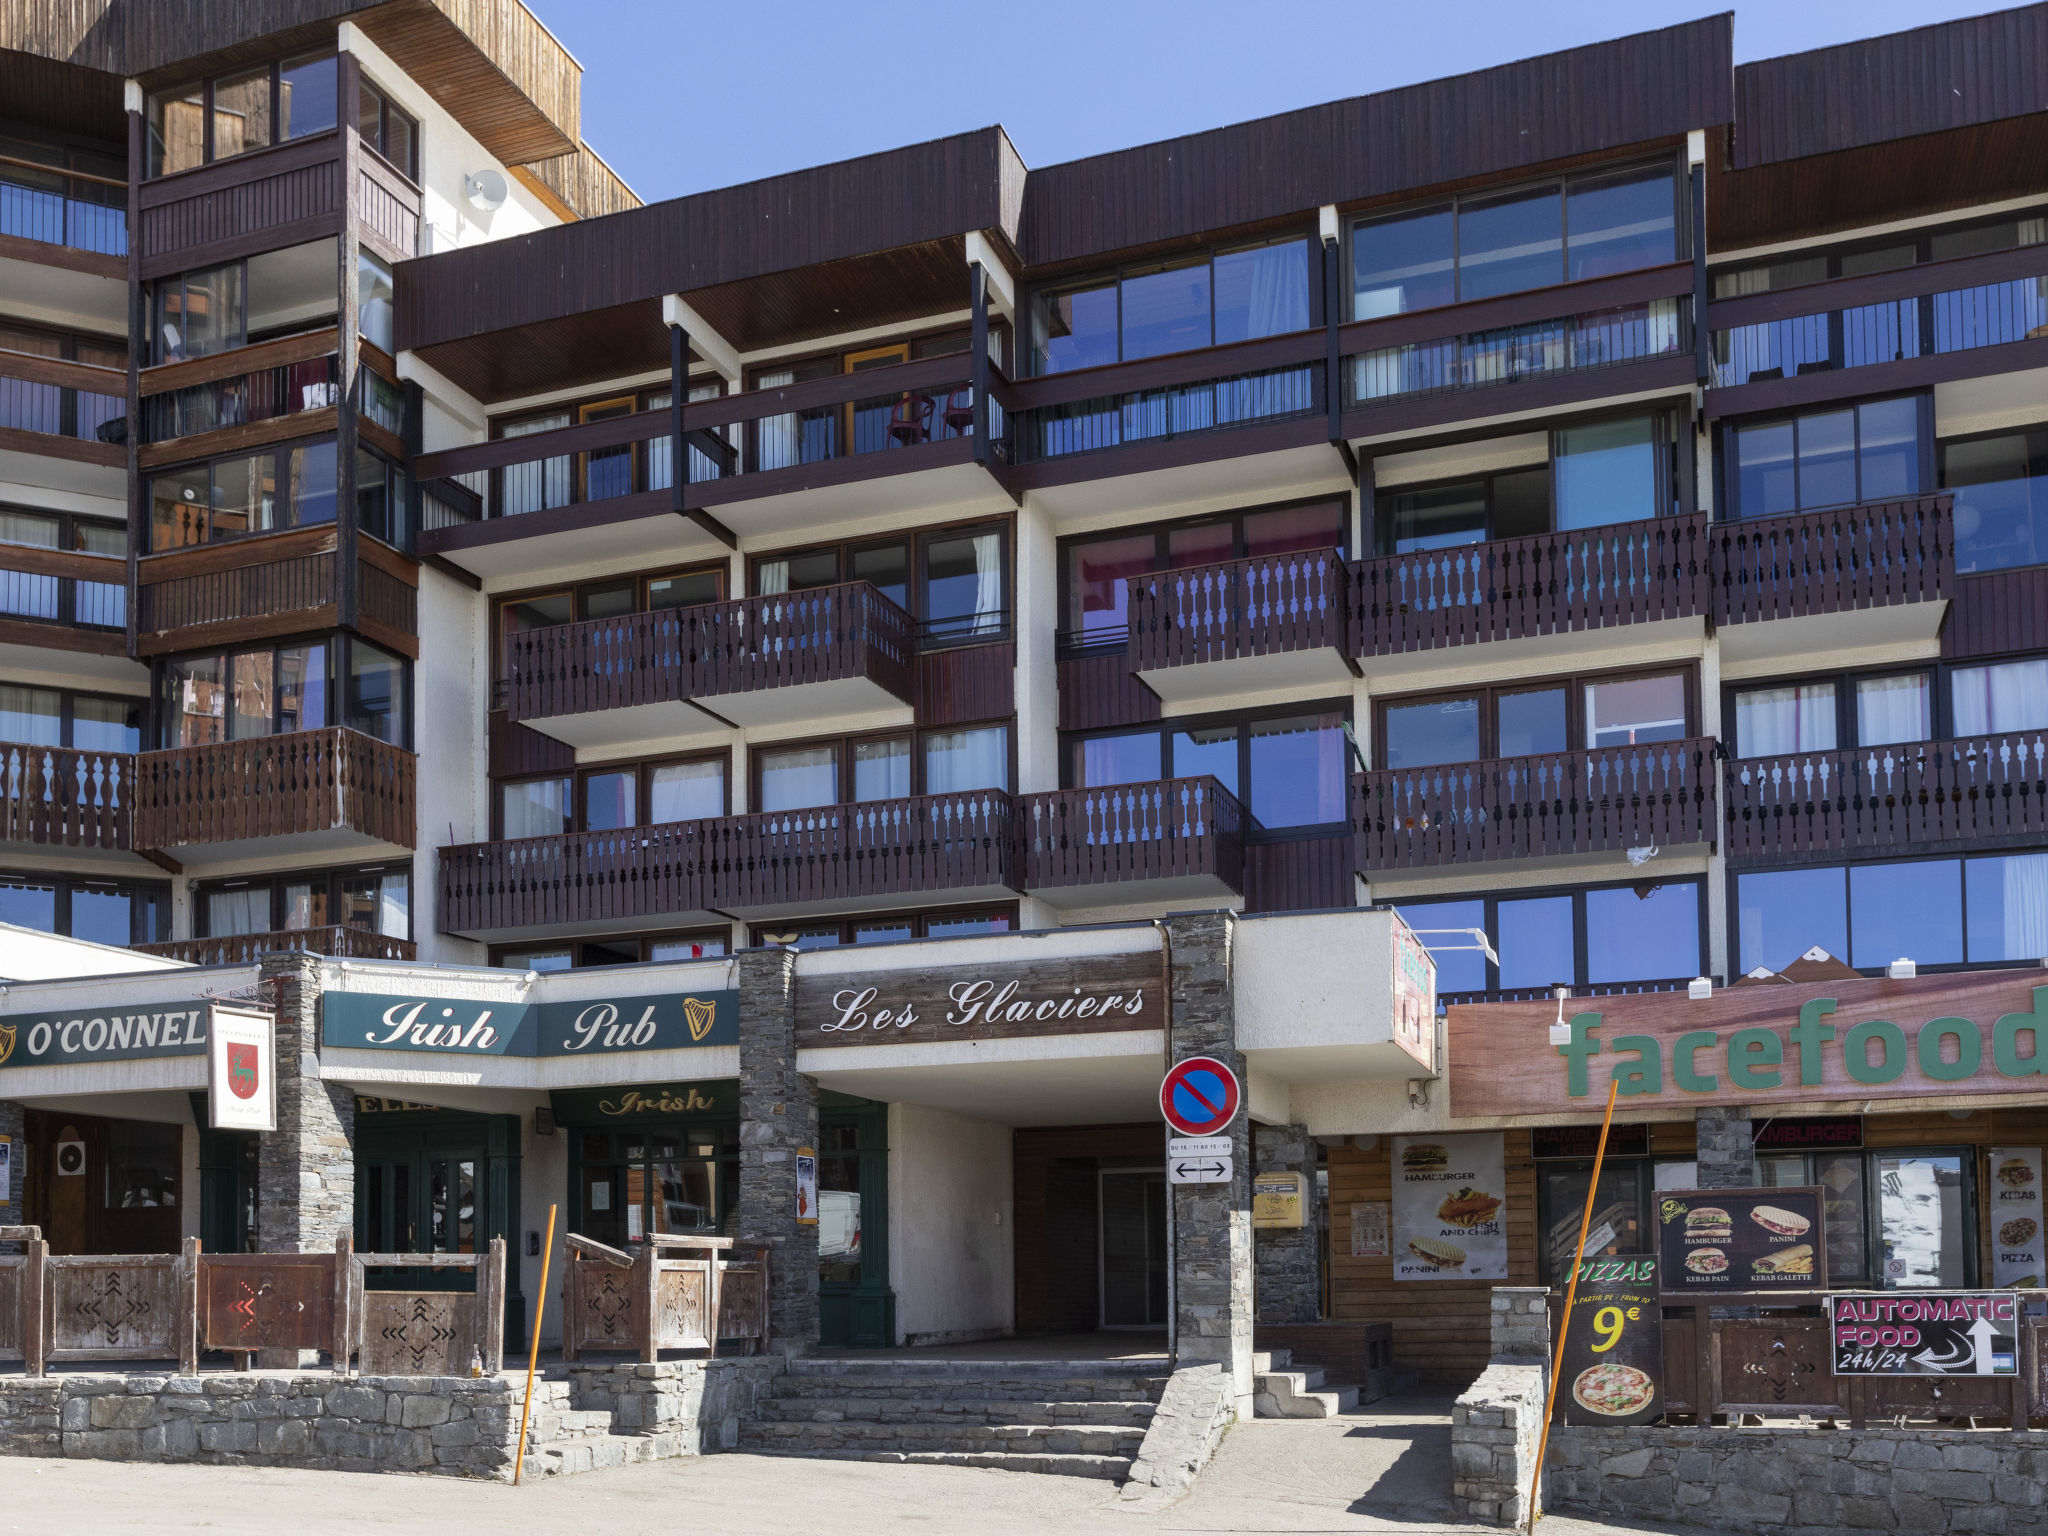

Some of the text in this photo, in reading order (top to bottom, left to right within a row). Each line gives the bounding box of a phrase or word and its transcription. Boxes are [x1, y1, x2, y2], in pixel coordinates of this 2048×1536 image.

[820, 979, 1144, 1032] Les Glaciers
[365, 1001, 657, 1050] Irish Pub
[1558, 984, 2048, 1098] facefood
[599, 1088, 715, 1115] Irish
[1404, 1172, 1475, 1181] HAMBURGER
[2000, 1190, 2036, 1200] KEBAB
[1475, 1221, 1498, 1229] FISH
[1440, 1228, 1500, 1237] AND CHIPS
[1685, 1236, 1732, 1246] HAMBURGER
[1769, 1235, 1796, 1243] PANINI
[2001, 1253, 2034, 1263] PIZZA
[1401, 1265, 1440, 1274] PANINI
[1564, 1260, 1656, 1284] PIZZAS
[1686, 1274, 1730, 1283] KEBAB PAIN
[1751, 1273, 1812, 1282] KEBAB GALETTE
[1579, 1294, 1603, 1304] PARTIR
[1620, 1294, 1640, 1303] FROM
[1641, 1297, 1651, 1305] TO
[1835, 1298, 2014, 1322] AUTOMATIC
[1836, 1325, 1921, 1348] FOOD
[1838, 1349, 1908, 1372] 24h/24
